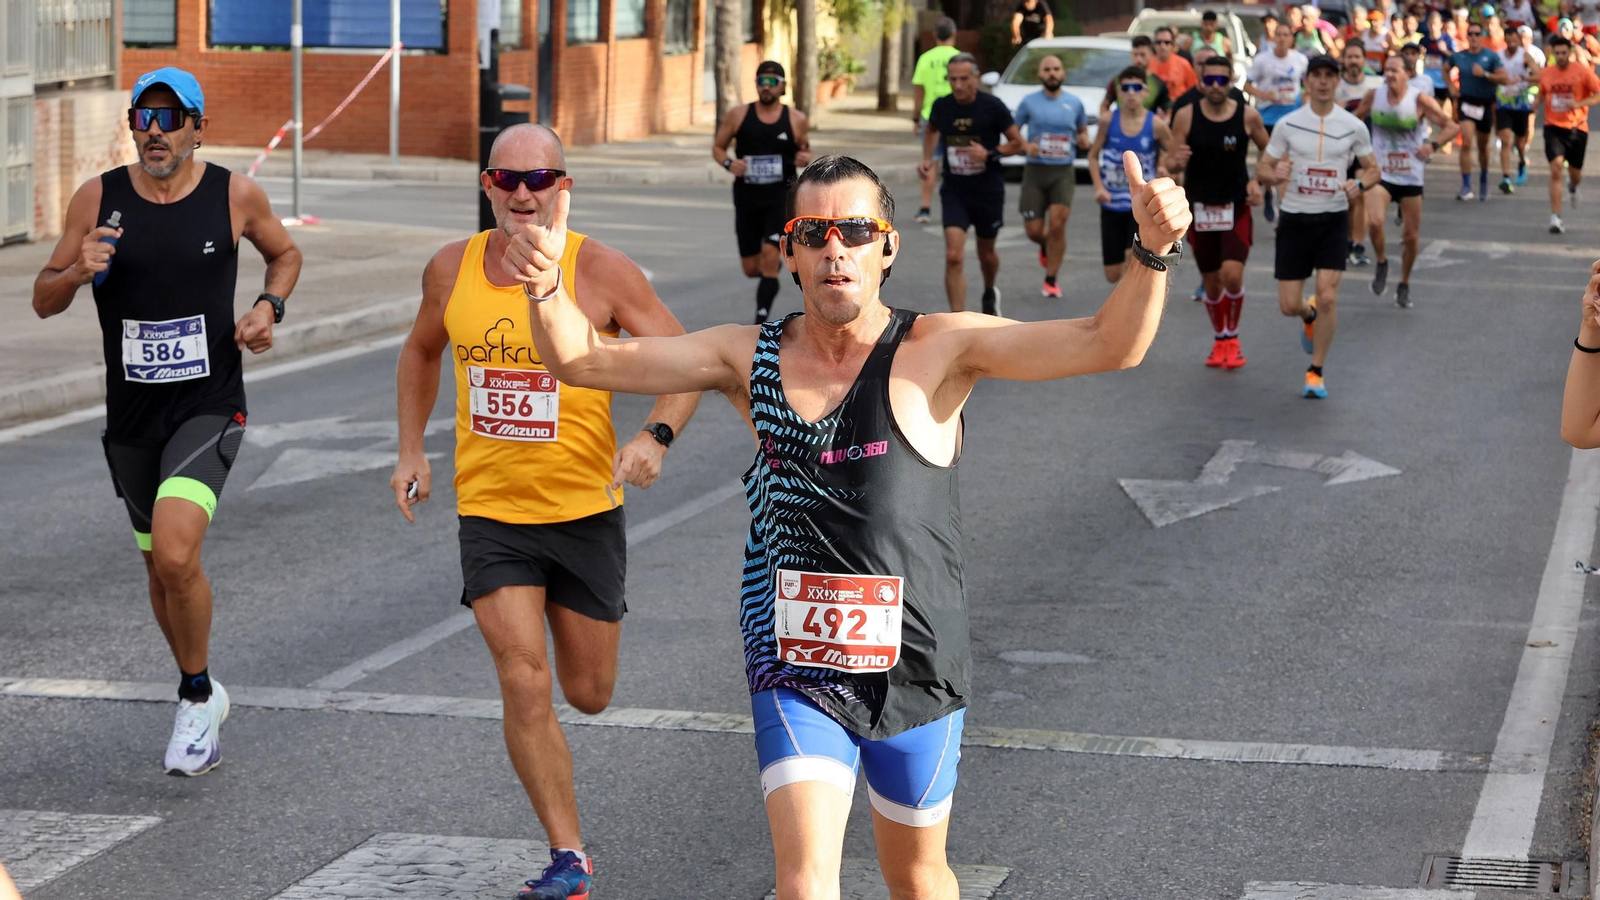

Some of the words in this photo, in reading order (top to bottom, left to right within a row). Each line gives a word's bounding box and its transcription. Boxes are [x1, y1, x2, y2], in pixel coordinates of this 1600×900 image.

[1309, 177, 1328, 188] 164
[142, 340, 185, 363] 586
[457, 333, 543, 365] parkru
[487, 392, 533, 417] 556
[802, 606, 867, 641] 492
